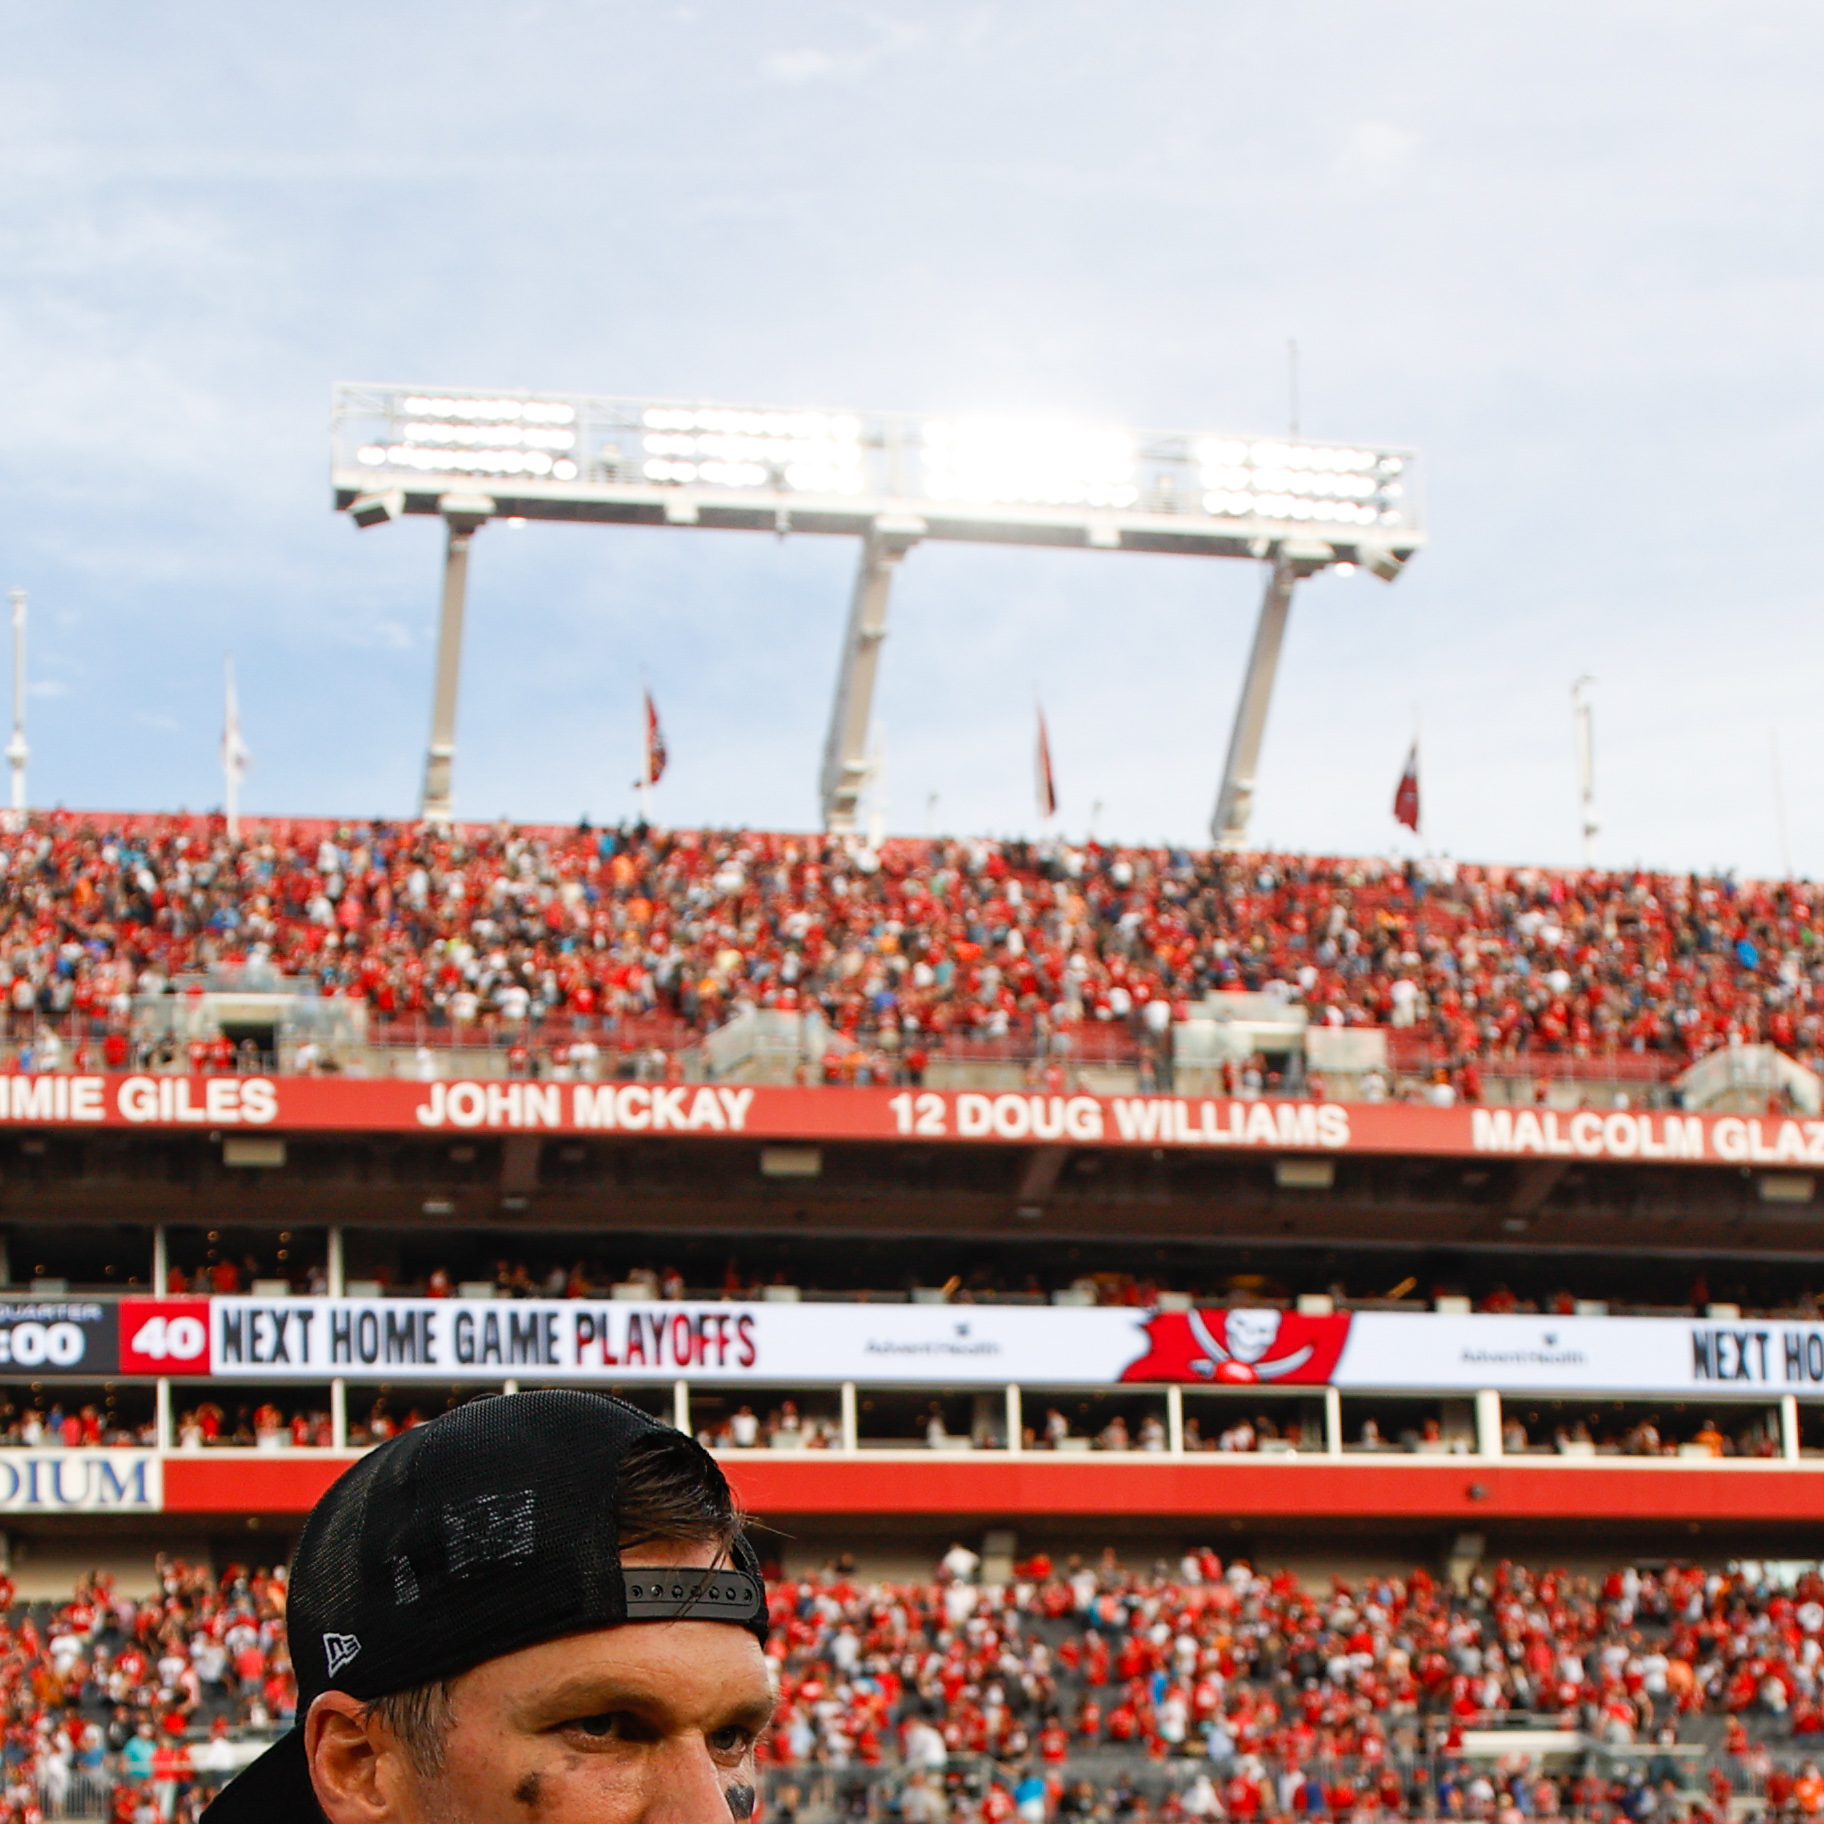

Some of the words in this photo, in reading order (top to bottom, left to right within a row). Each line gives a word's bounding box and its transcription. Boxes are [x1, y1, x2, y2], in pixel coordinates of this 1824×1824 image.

[117, 1077, 278, 1124] GILES
[416, 1082, 561, 1129] JOHN
[575, 1083, 755, 1132] MCKAY
[889, 1093, 946, 1136] 12
[957, 1095, 1103, 1141] DOUG
[1112, 1098, 1351, 1148] WILLIAMS
[1472, 1108, 1704, 1159] MALCOLM
[131, 1315, 207, 1361] 40
[219, 1308, 314, 1364] NEXT
[330, 1309, 438, 1365] HOME
[454, 1310, 562, 1366] GAME
[576, 1312, 757, 1368] PLAYOFFS
[1692, 1330, 1769, 1382] NEXT
